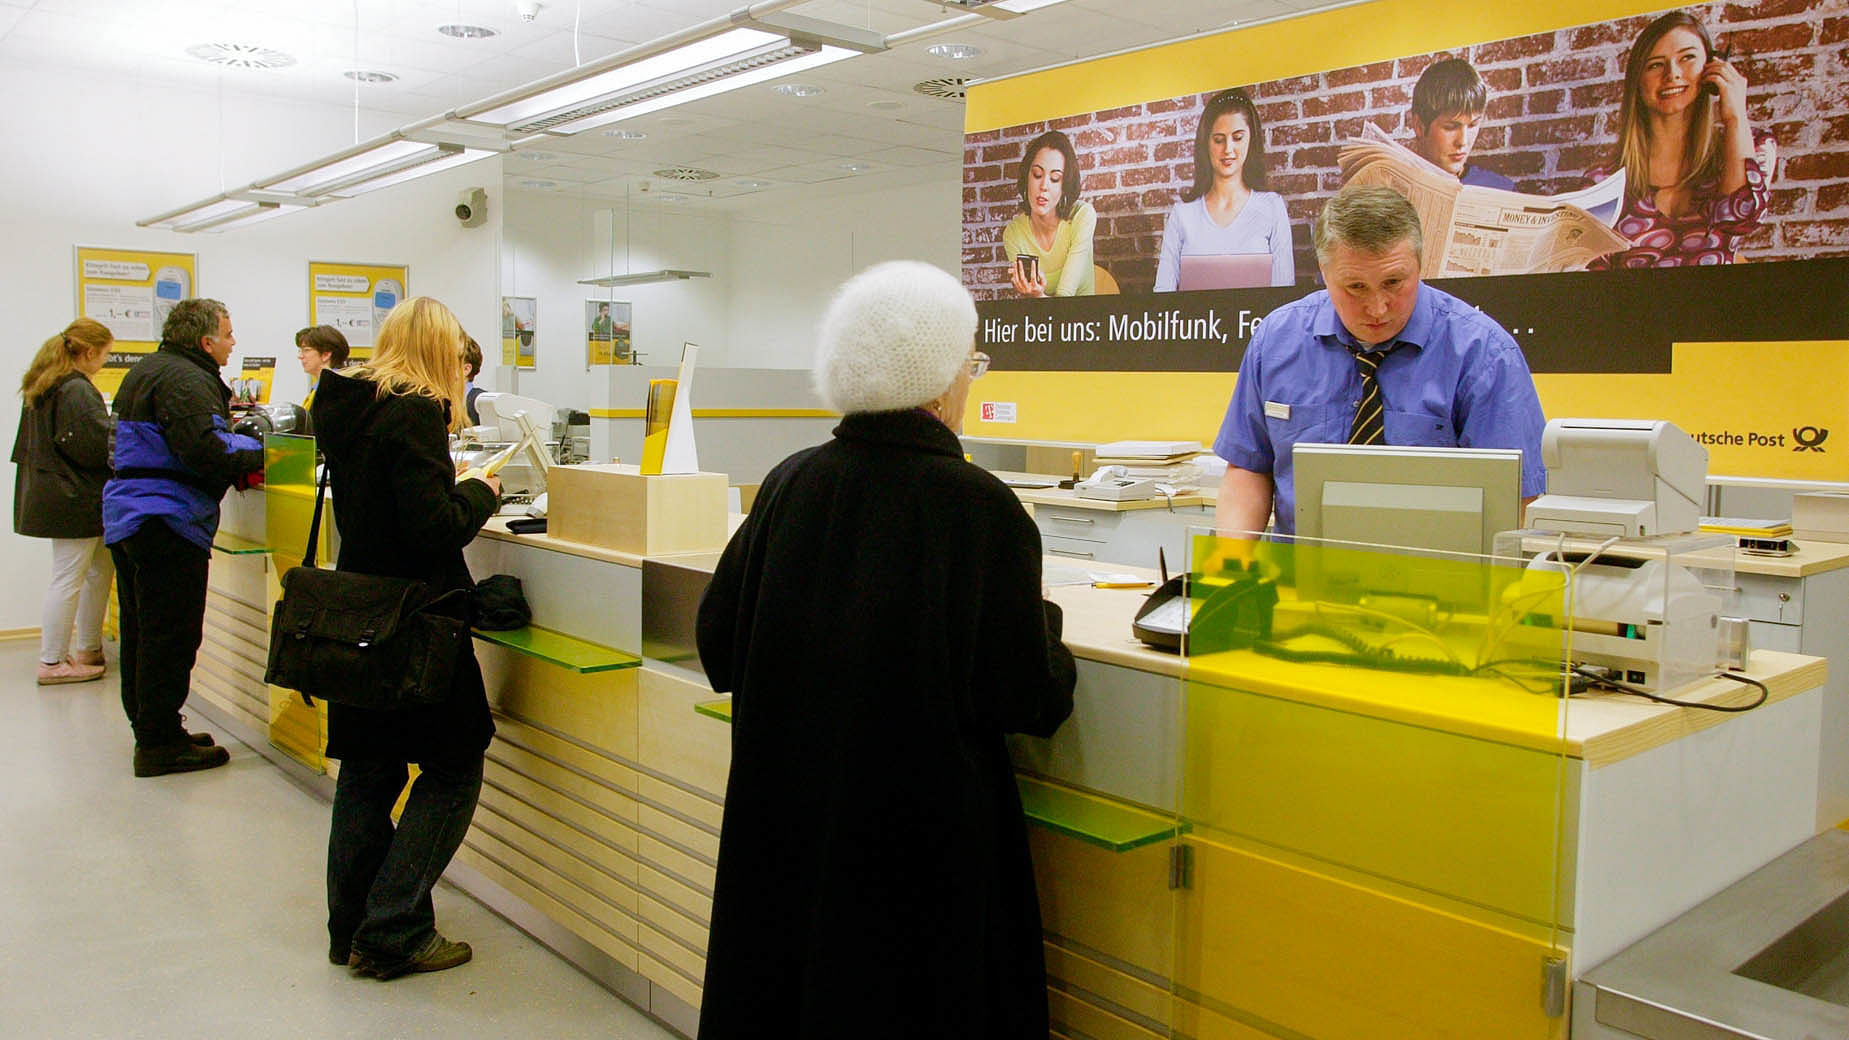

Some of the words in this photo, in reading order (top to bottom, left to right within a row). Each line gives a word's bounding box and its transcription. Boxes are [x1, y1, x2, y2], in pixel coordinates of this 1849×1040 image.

[1503, 212, 1531, 225] MONEY
[984, 318, 1018, 344] Hier
[1024, 315, 1053, 343] bei
[1060, 320, 1101, 343] uns:
[1108, 309, 1227, 344] Mobilfunk,
[1238, 310, 1263, 339] Fe
[1690, 430, 1744, 446] utsche
[1748, 432, 1785, 448] Post
